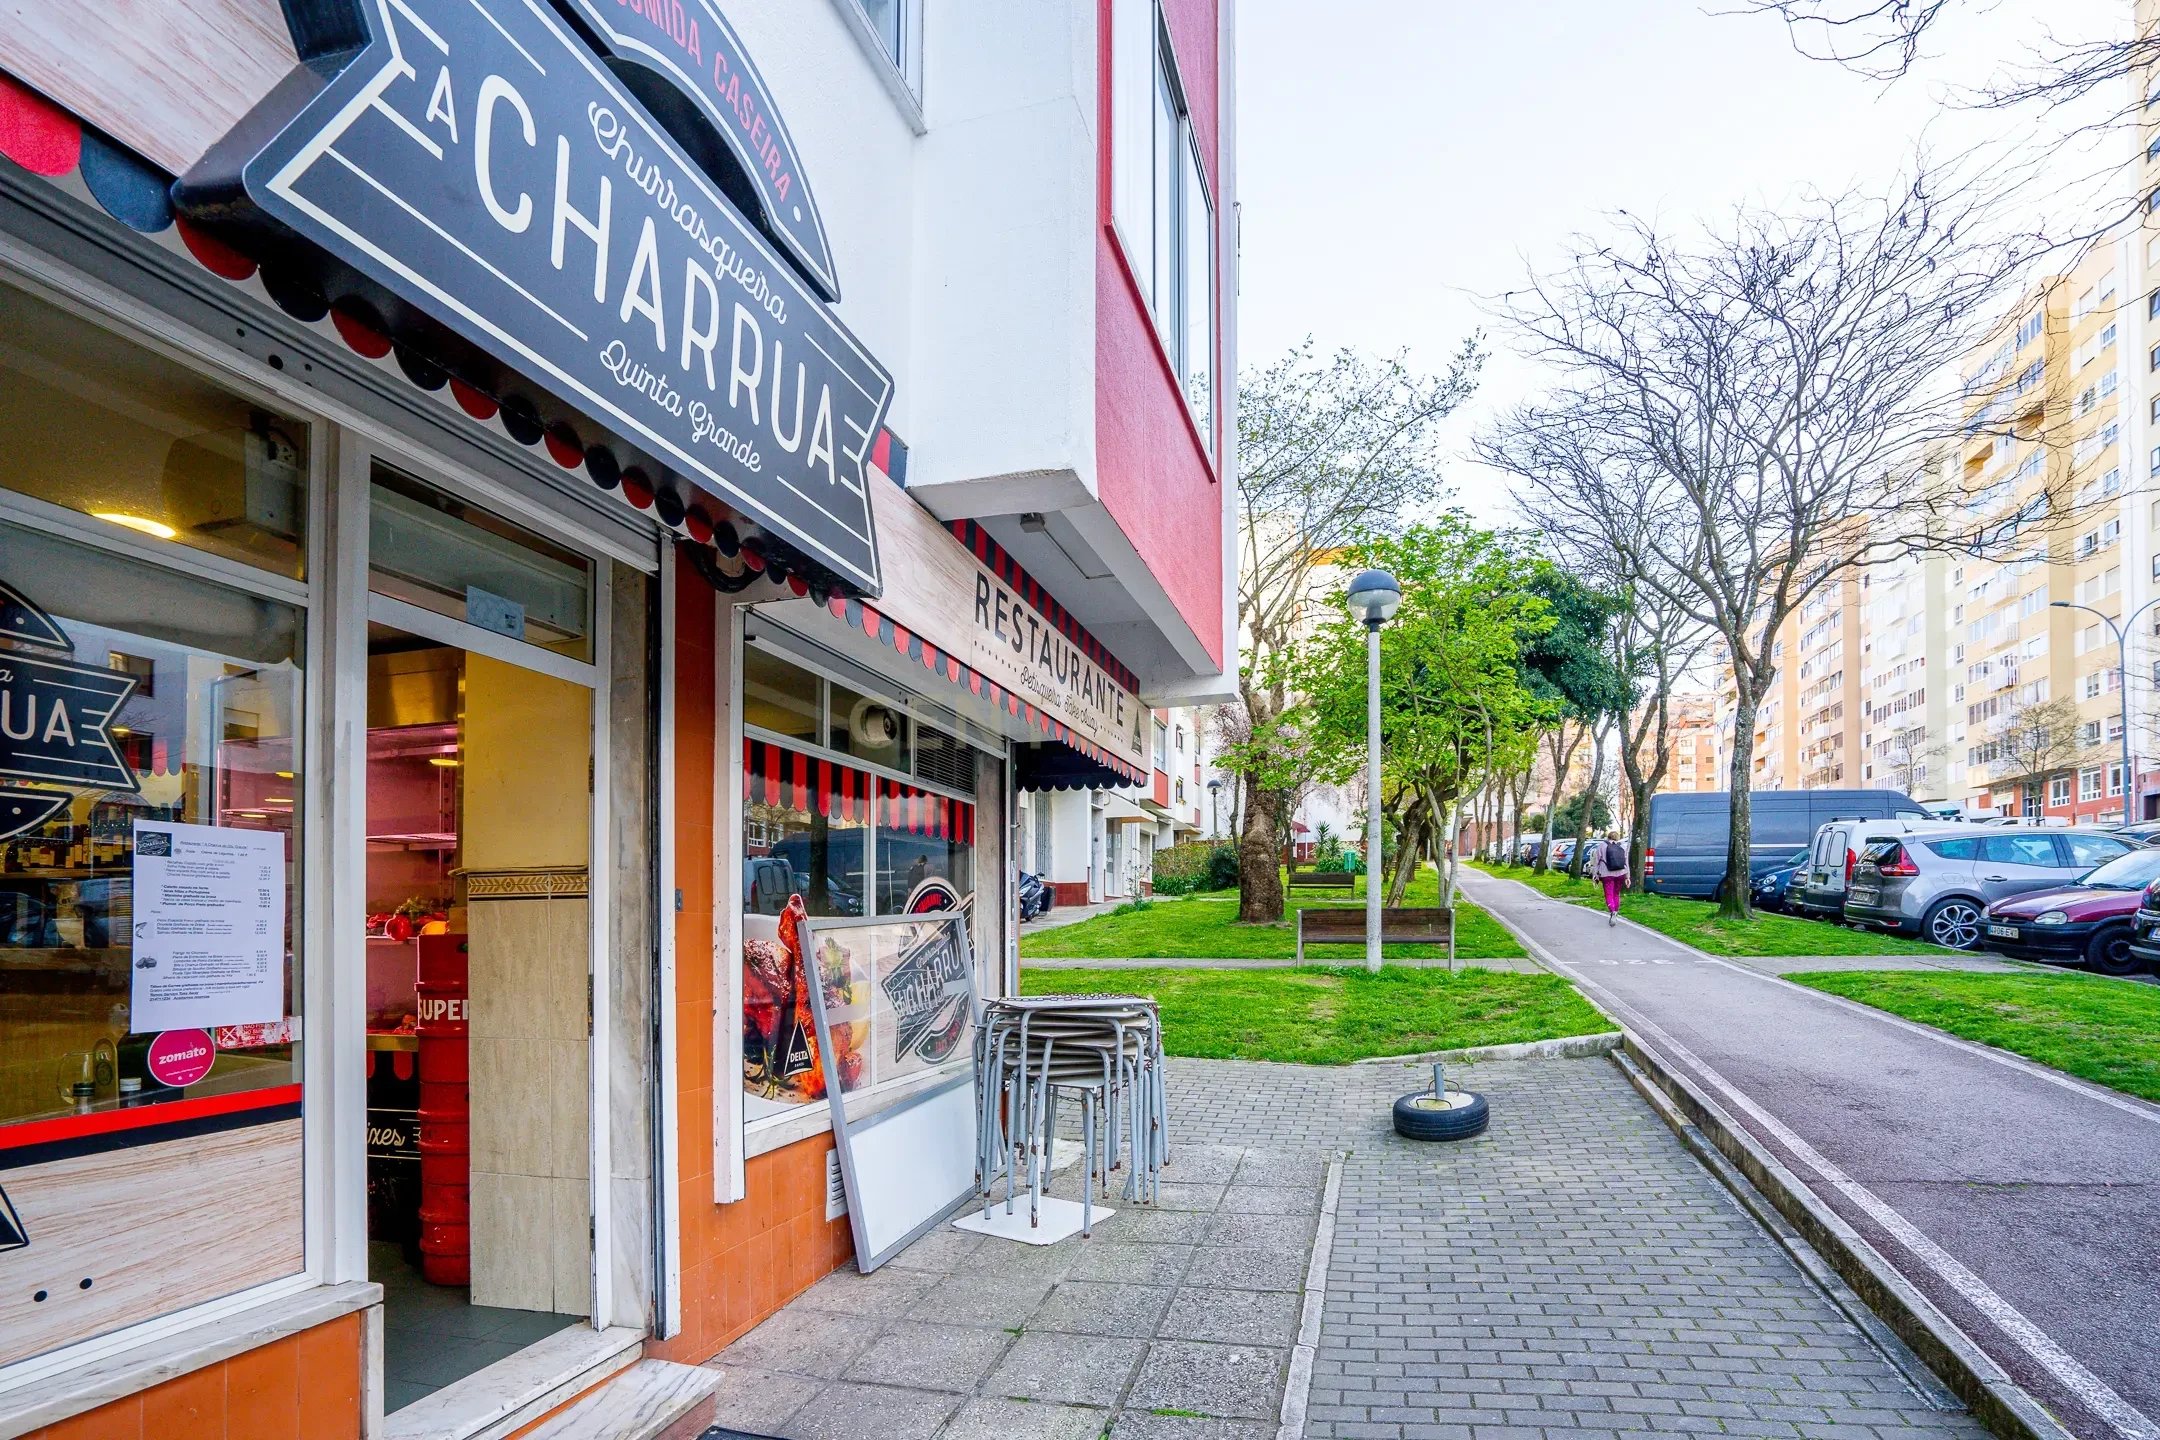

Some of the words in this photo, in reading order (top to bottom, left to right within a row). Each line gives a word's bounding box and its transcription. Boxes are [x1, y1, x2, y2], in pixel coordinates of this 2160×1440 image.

[616, 0, 703, 68] MIDA
[713, 51, 791, 202] CASEIRA
[426, 64, 459, 143] A
[474, 74, 836, 485] CHARRUA
[587, 100, 788, 324] Churrasqueira
[599, 339, 683, 417] Quinta
[688, 400, 762, 472] Grande
[974, 570, 1125, 727] RESTAURANTE
[158, 1047, 207, 1065] zomato
[790, 1050, 809, 1063] DELTA
